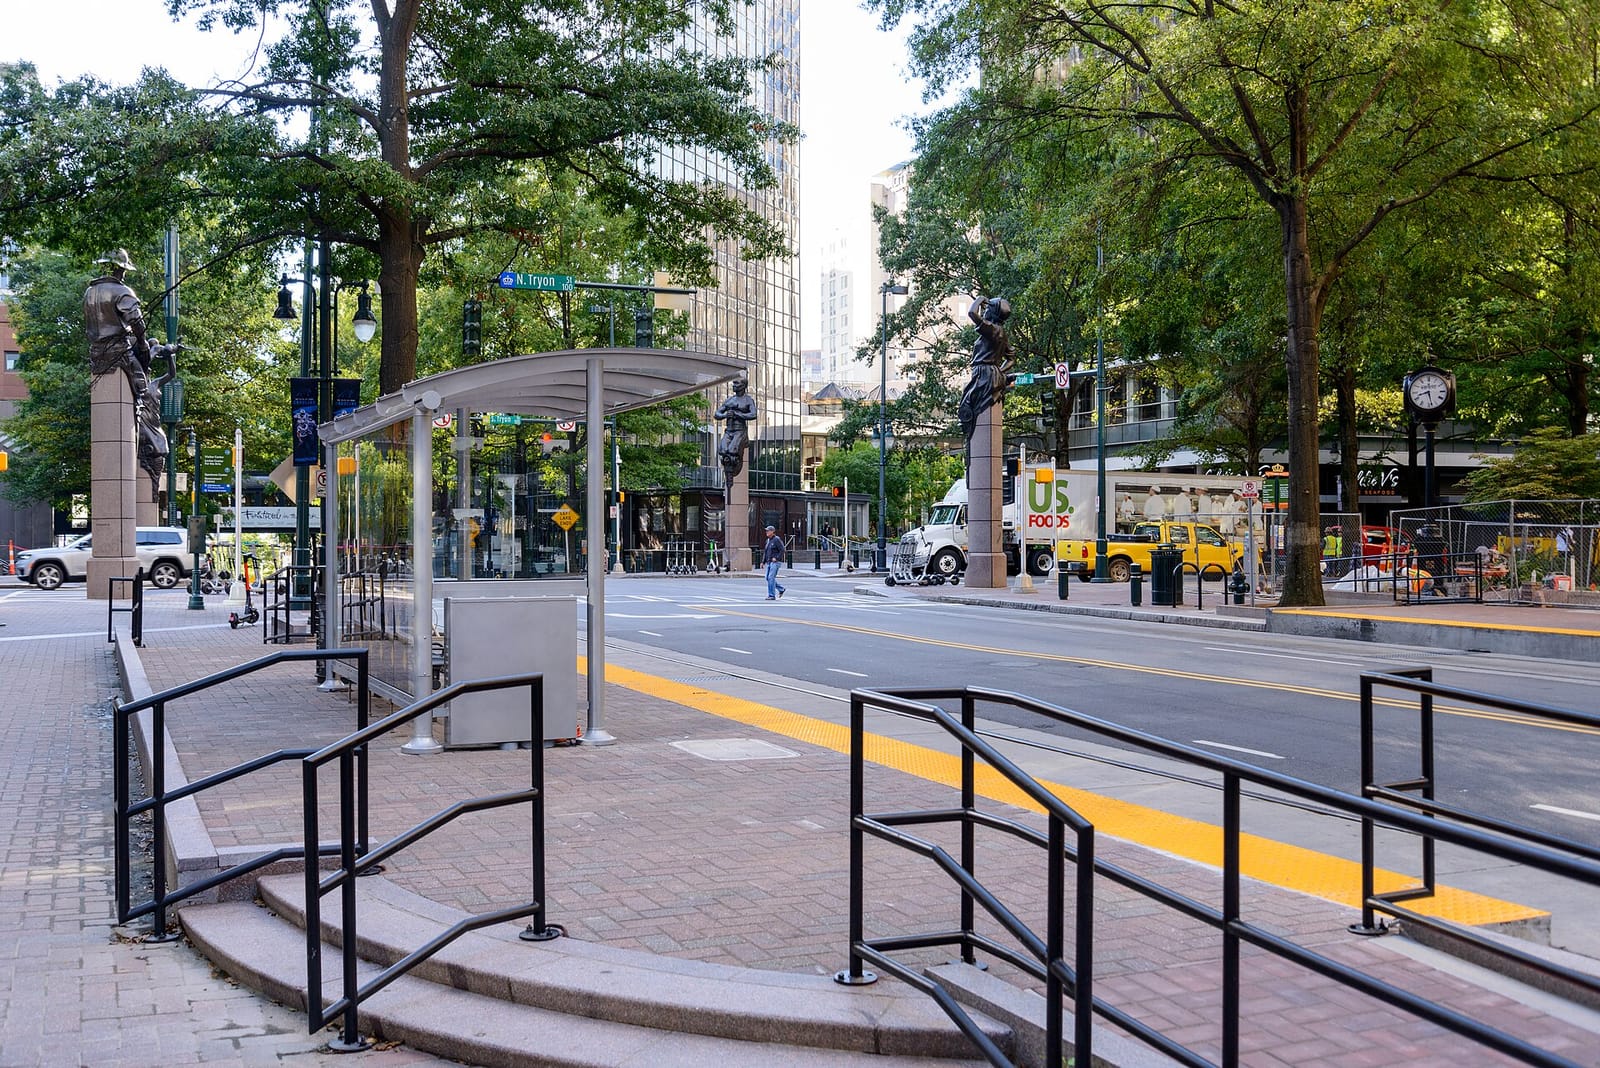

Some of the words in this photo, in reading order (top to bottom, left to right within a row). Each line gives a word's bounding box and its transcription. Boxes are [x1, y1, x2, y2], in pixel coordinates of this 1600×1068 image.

[516, 273, 527, 286] N.
[528, 274, 555, 289] Tryon
[566, 276, 573, 284] St
[1028, 514, 1070, 528] FOODS
